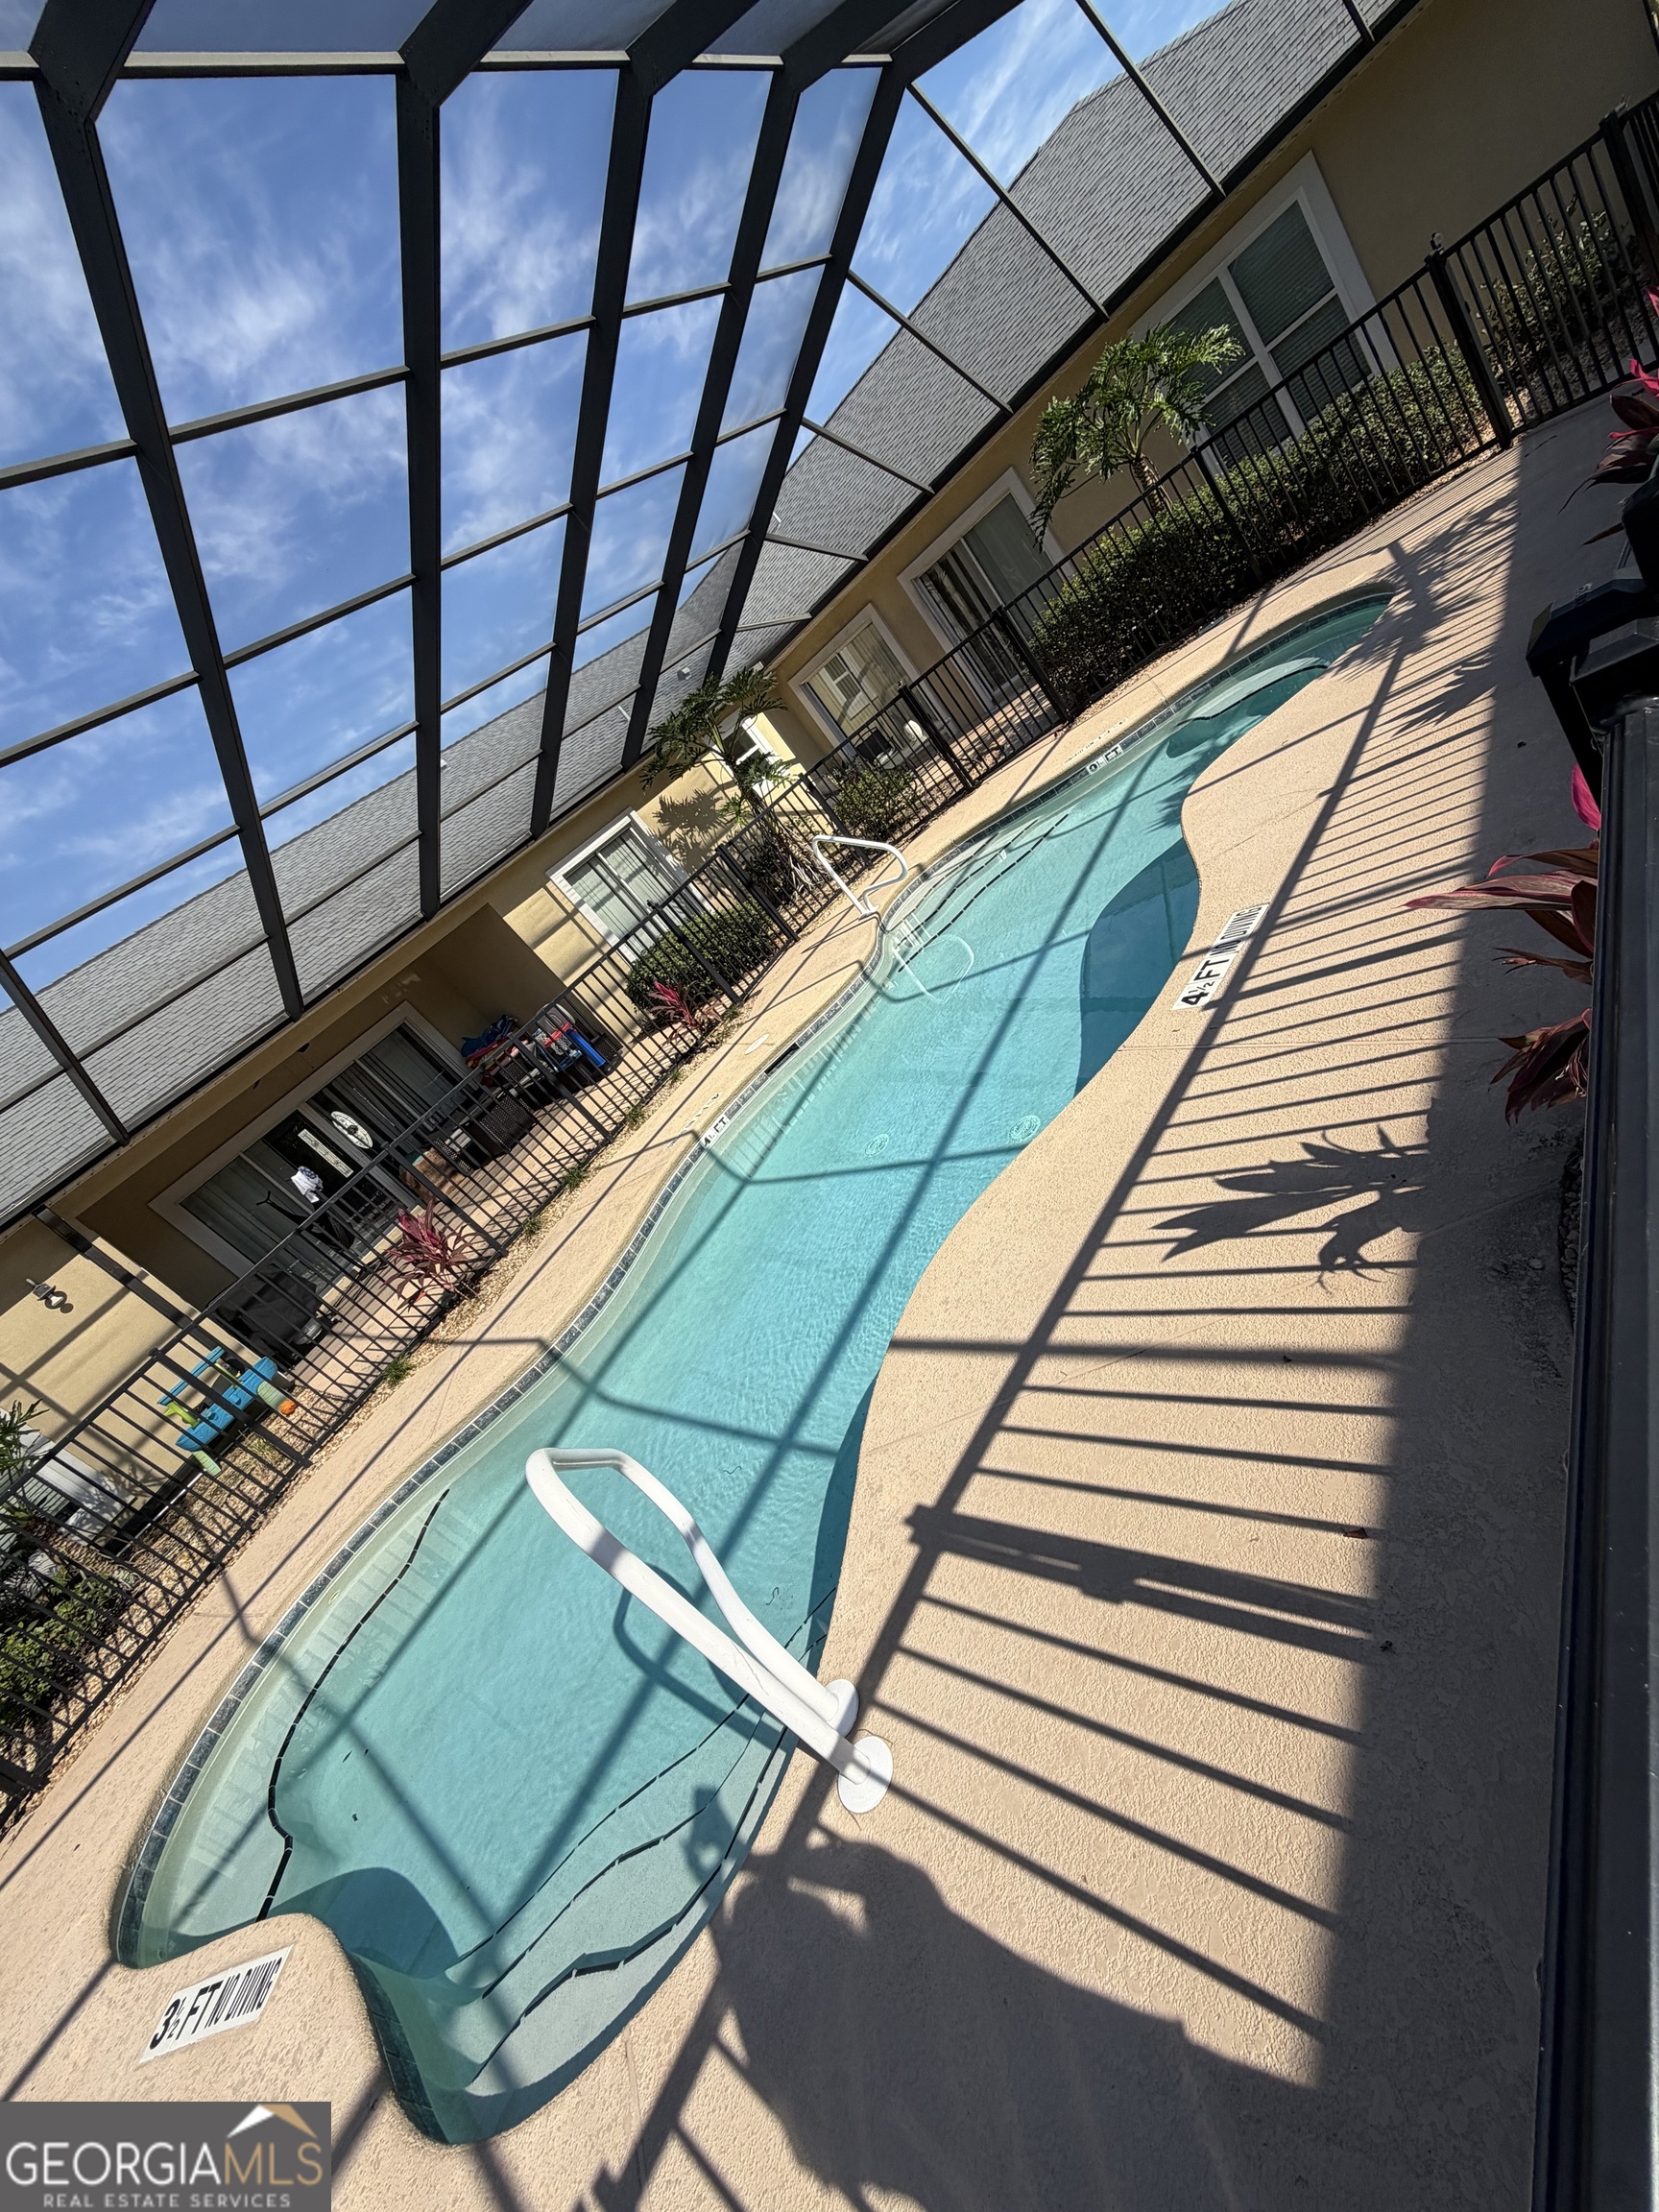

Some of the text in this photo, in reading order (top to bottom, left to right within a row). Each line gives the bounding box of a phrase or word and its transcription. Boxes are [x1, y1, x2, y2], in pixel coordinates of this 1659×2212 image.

[1220, 906, 1262, 940] DIVING
[1210, 940, 1242, 956] NO
[1193, 959, 1230, 981] FT
[176, 1980, 224, 2040] FT
[204, 1973, 241, 2029] NO
[224, 1957, 282, 2021] DIVING
